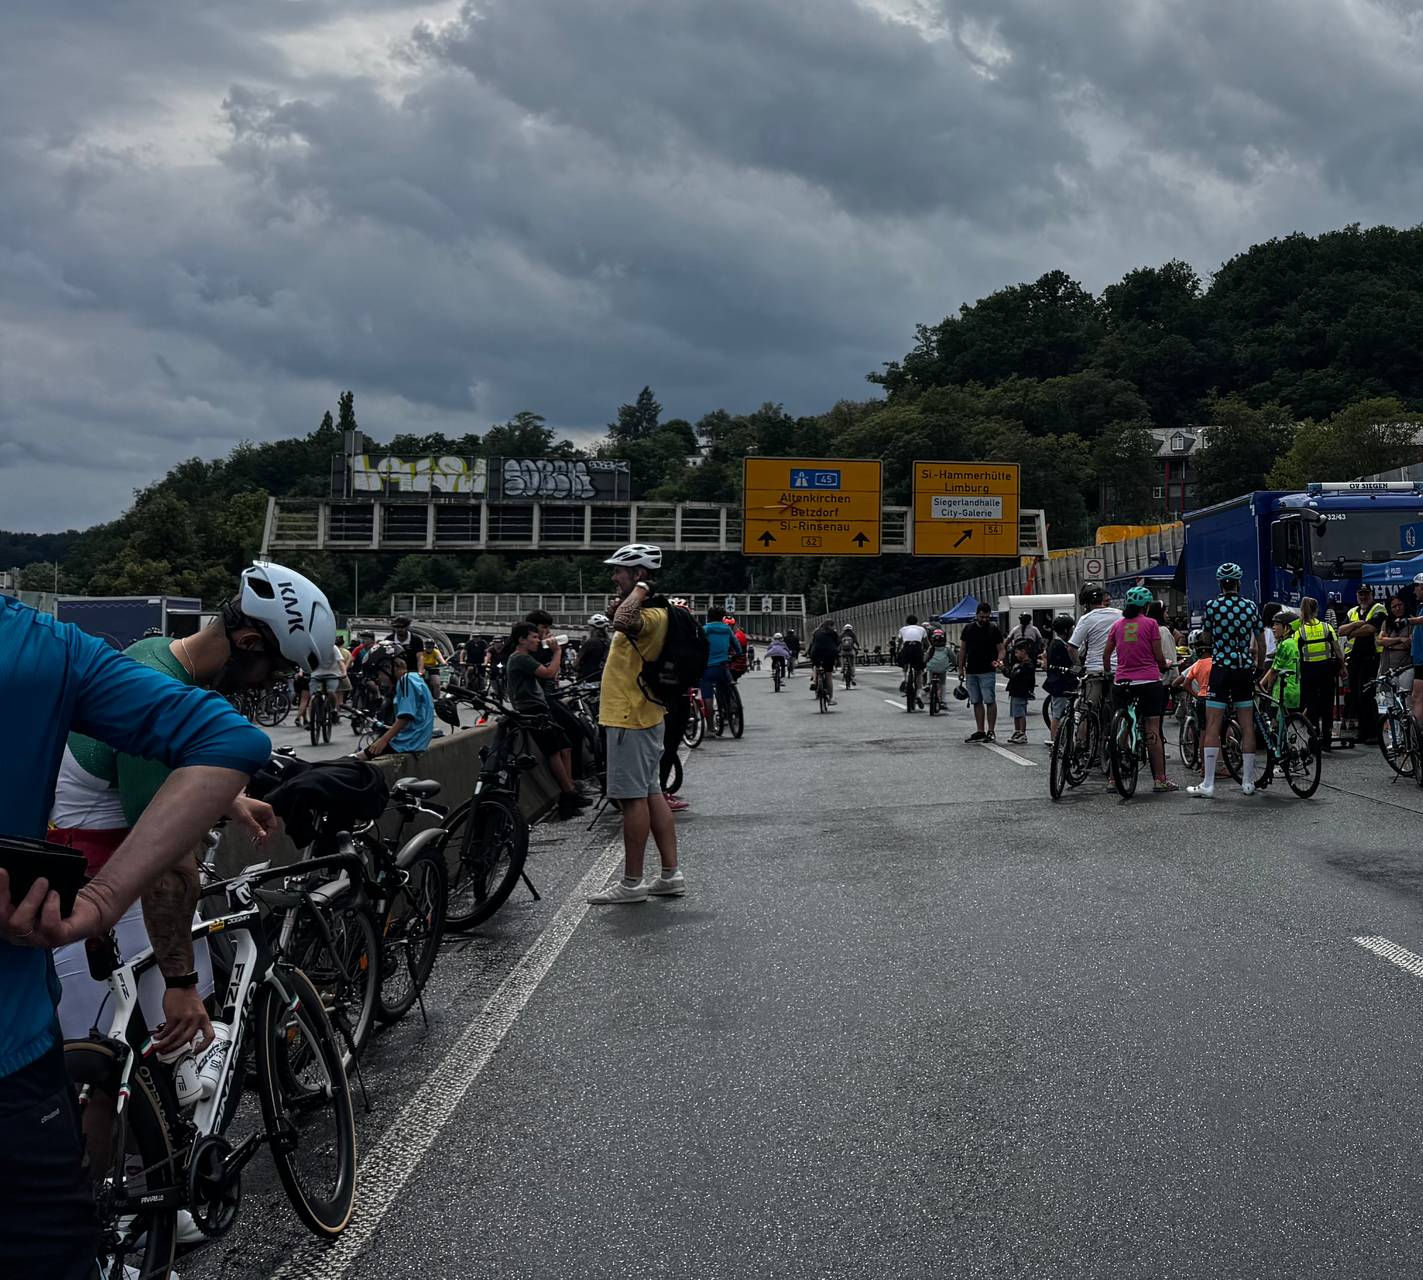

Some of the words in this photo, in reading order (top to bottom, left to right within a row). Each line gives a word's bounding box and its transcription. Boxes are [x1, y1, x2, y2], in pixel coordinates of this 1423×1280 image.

[820, 475, 832, 484] 45
[921, 469, 1012, 480] Si.-Hammerhütte
[944, 482, 989, 494] Limburg
[781, 493, 851, 503] Altenkirchen
[934, 498, 1000, 507] Siegerlandhalle
[791, 508, 838, 517] Betzdorf
[941, 508, 992, 517] City-Galerie
[806, 538, 817, 546] 62
[1369, 584, 1405, 600] HW
[278, 582, 304, 634] KASK
[1124, 623, 1138, 641] 2
